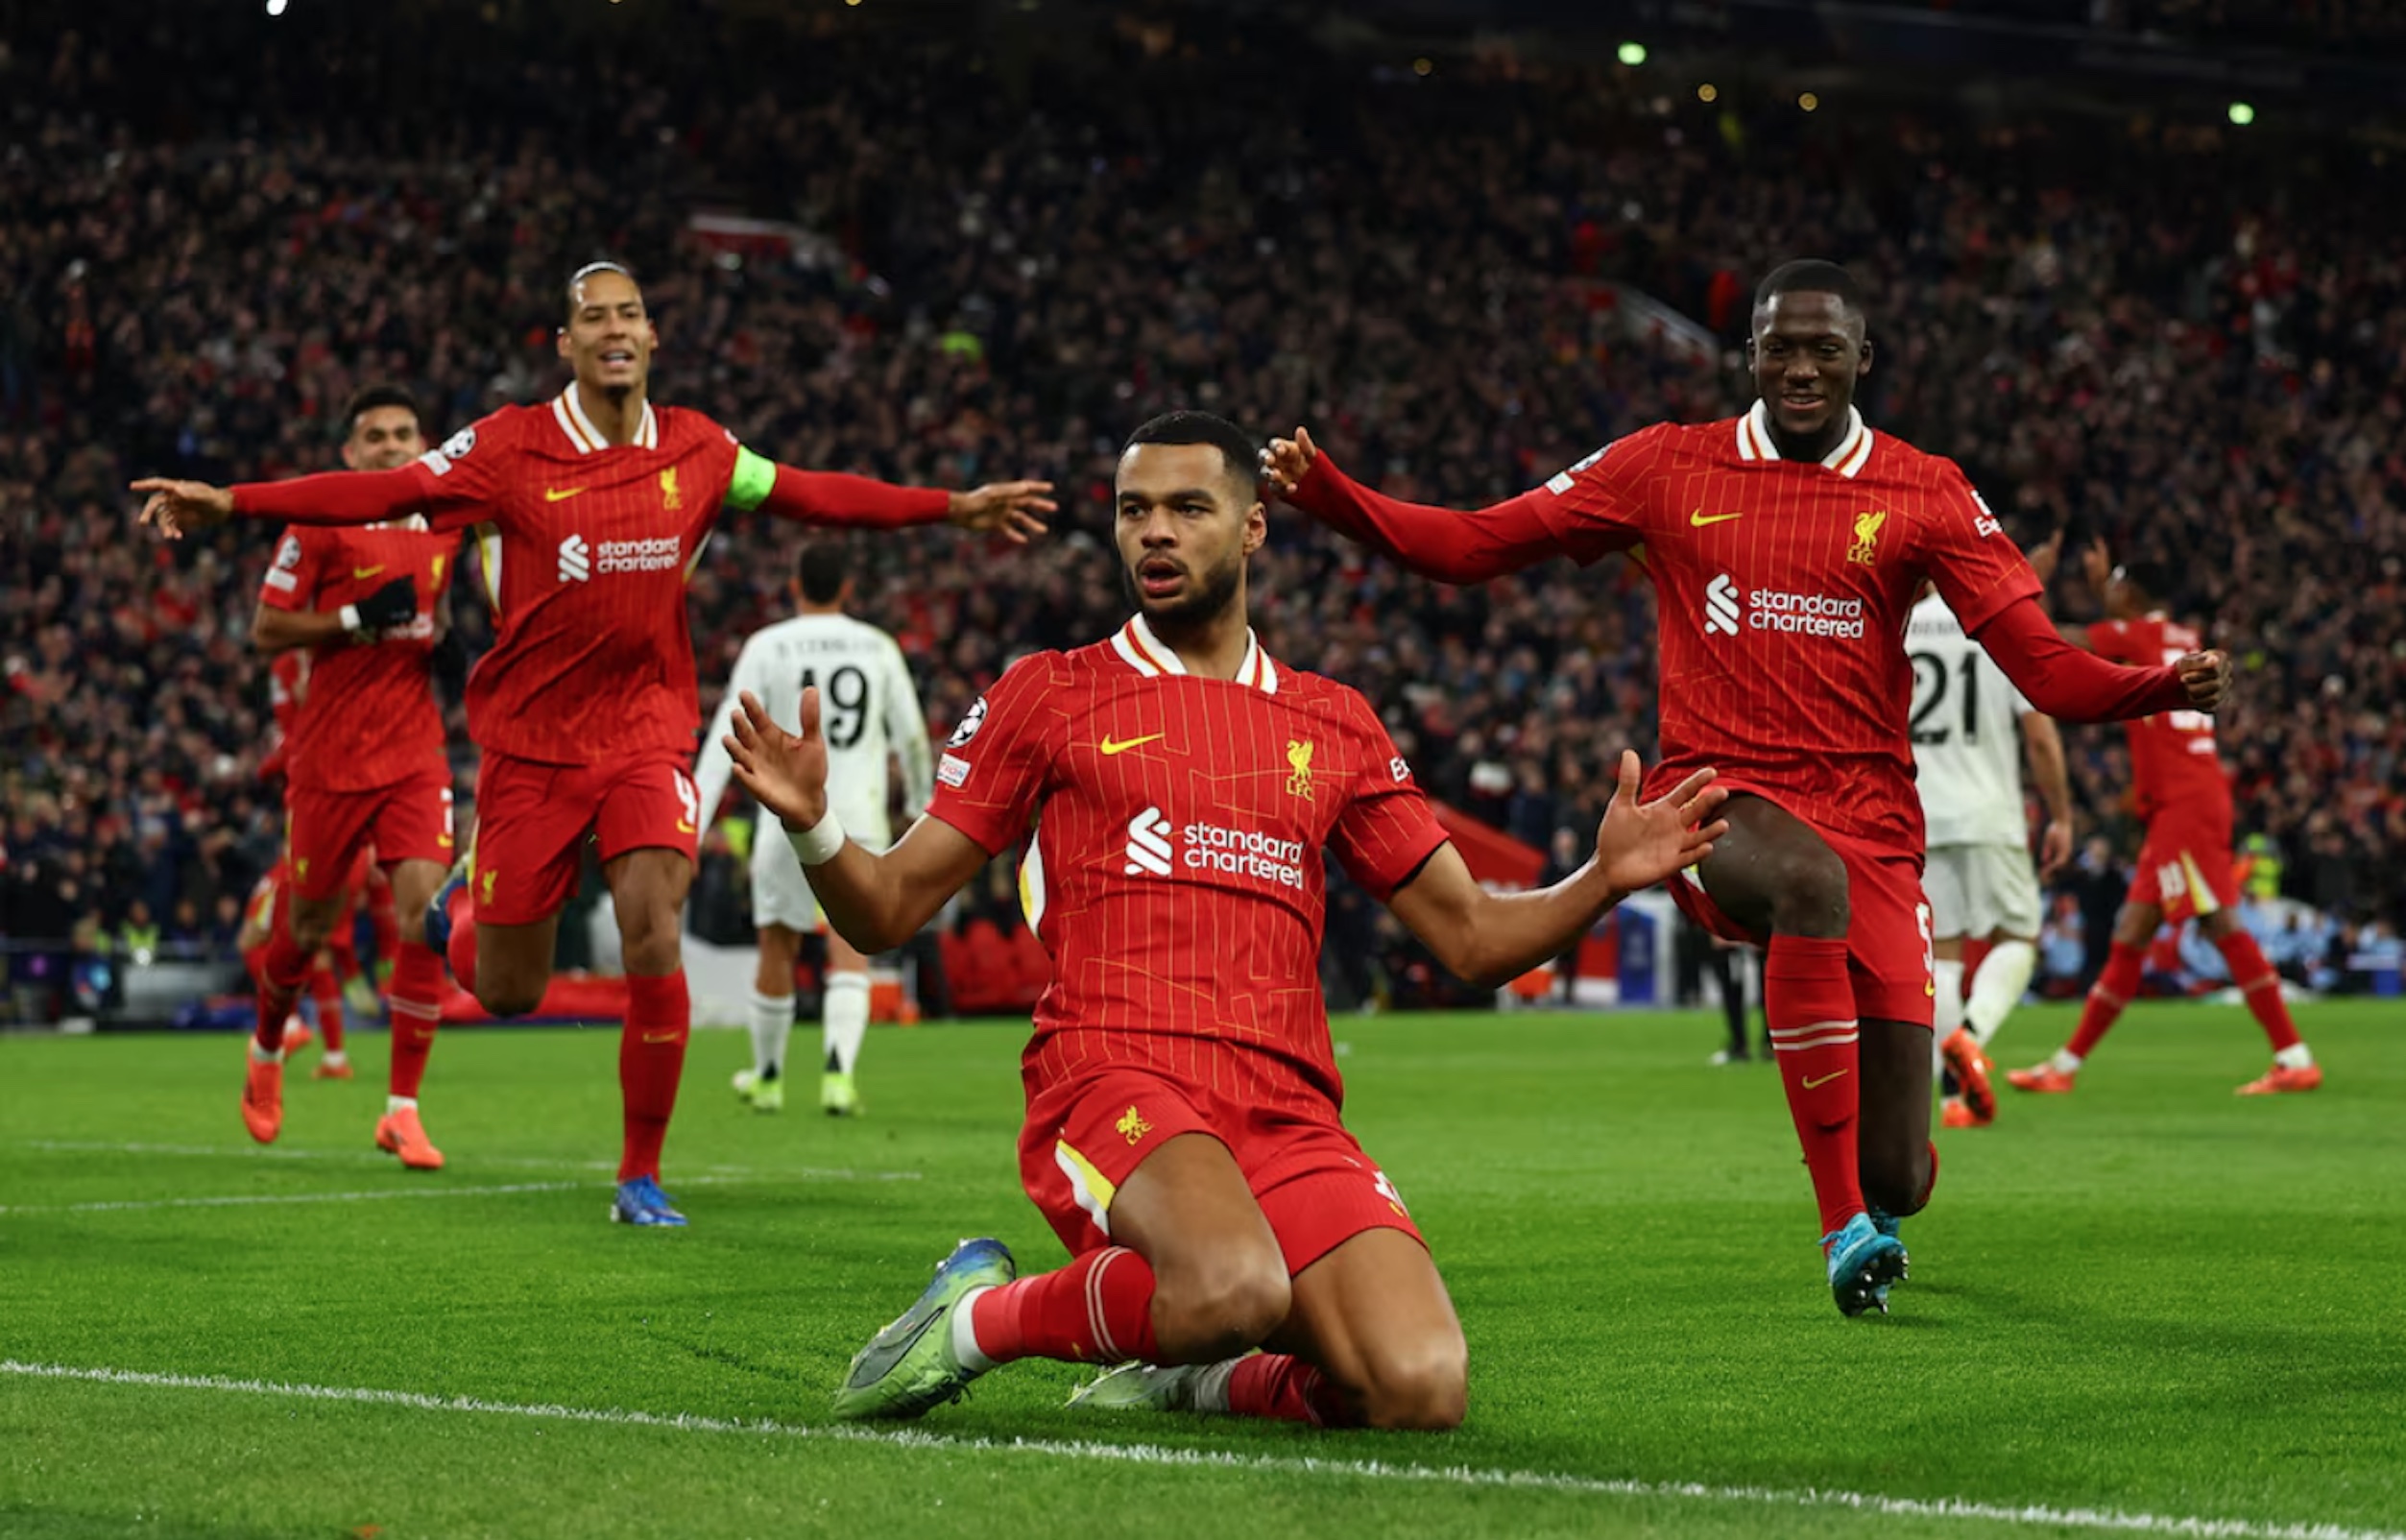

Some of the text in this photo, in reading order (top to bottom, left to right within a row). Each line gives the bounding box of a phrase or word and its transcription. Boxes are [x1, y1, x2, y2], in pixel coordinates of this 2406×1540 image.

[597, 535, 681, 558] standard
[1847, 543, 1875, 566] LFC
[597, 551, 681, 574] chartered
[1749, 587, 1863, 617] standard
[1749, 609, 1865, 638] chartered
[1909, 651, 1978, 747] 21
[674, 768, 698, 826] 4
[1286, 776, 1314, 801] LFC
[1183, 822, 1304, 864] standard
[1184, 846, 1304, 890] chartered
